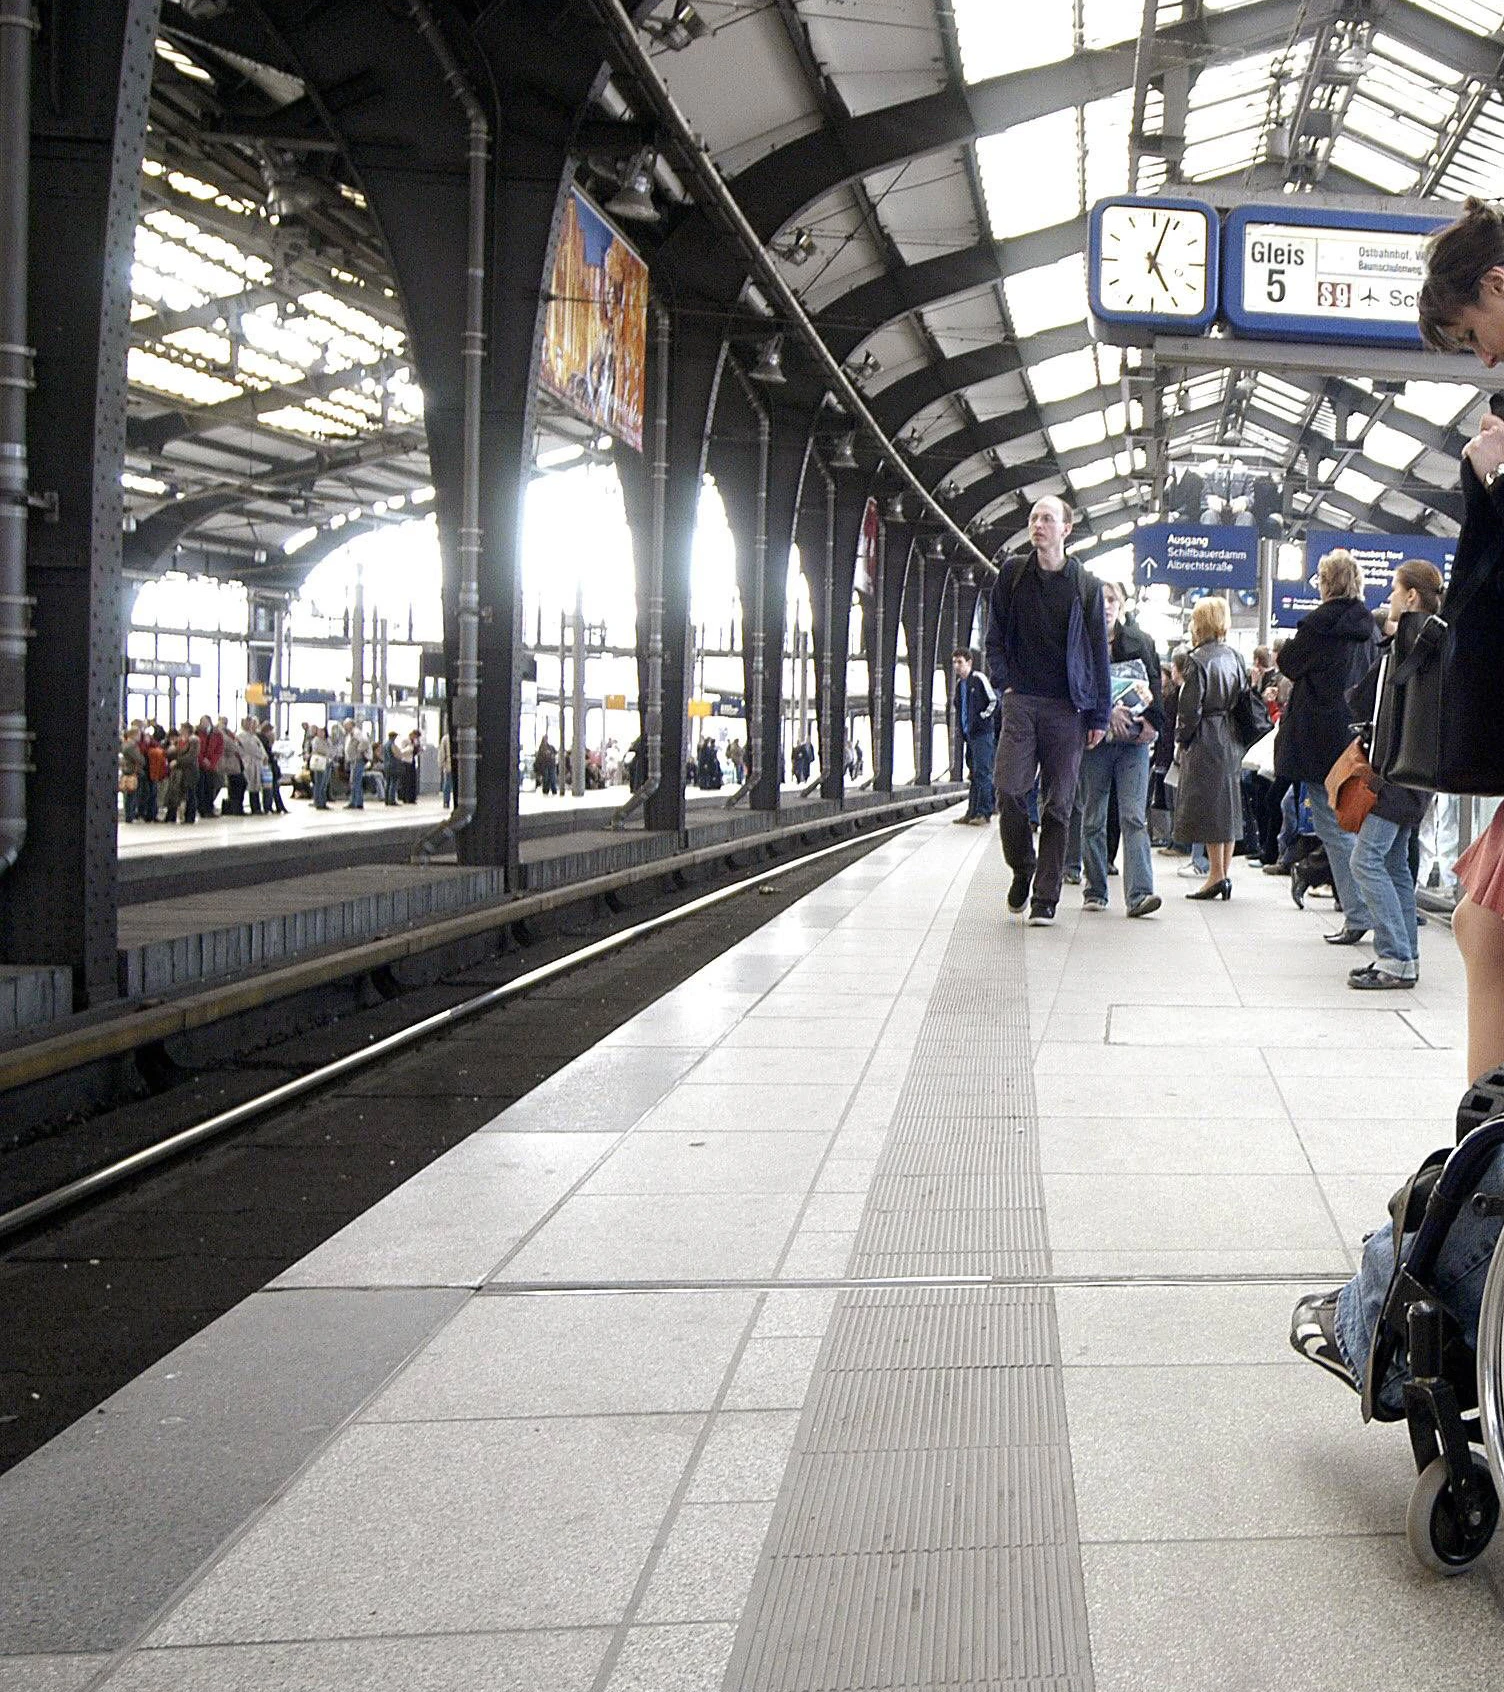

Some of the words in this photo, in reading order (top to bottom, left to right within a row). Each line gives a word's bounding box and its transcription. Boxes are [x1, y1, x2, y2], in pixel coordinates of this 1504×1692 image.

[1251, 241, 1305, 266] Gleis
[1266, 268, 1287, 303] 5
[1318, 282, 1351, 307] S9
[1167, 533, 1209, 548] Ausgang
[1167, 546, 1247, 560] Schiffbauerdamm
[1166, 559, 1234, 572] Albrechtstraße
